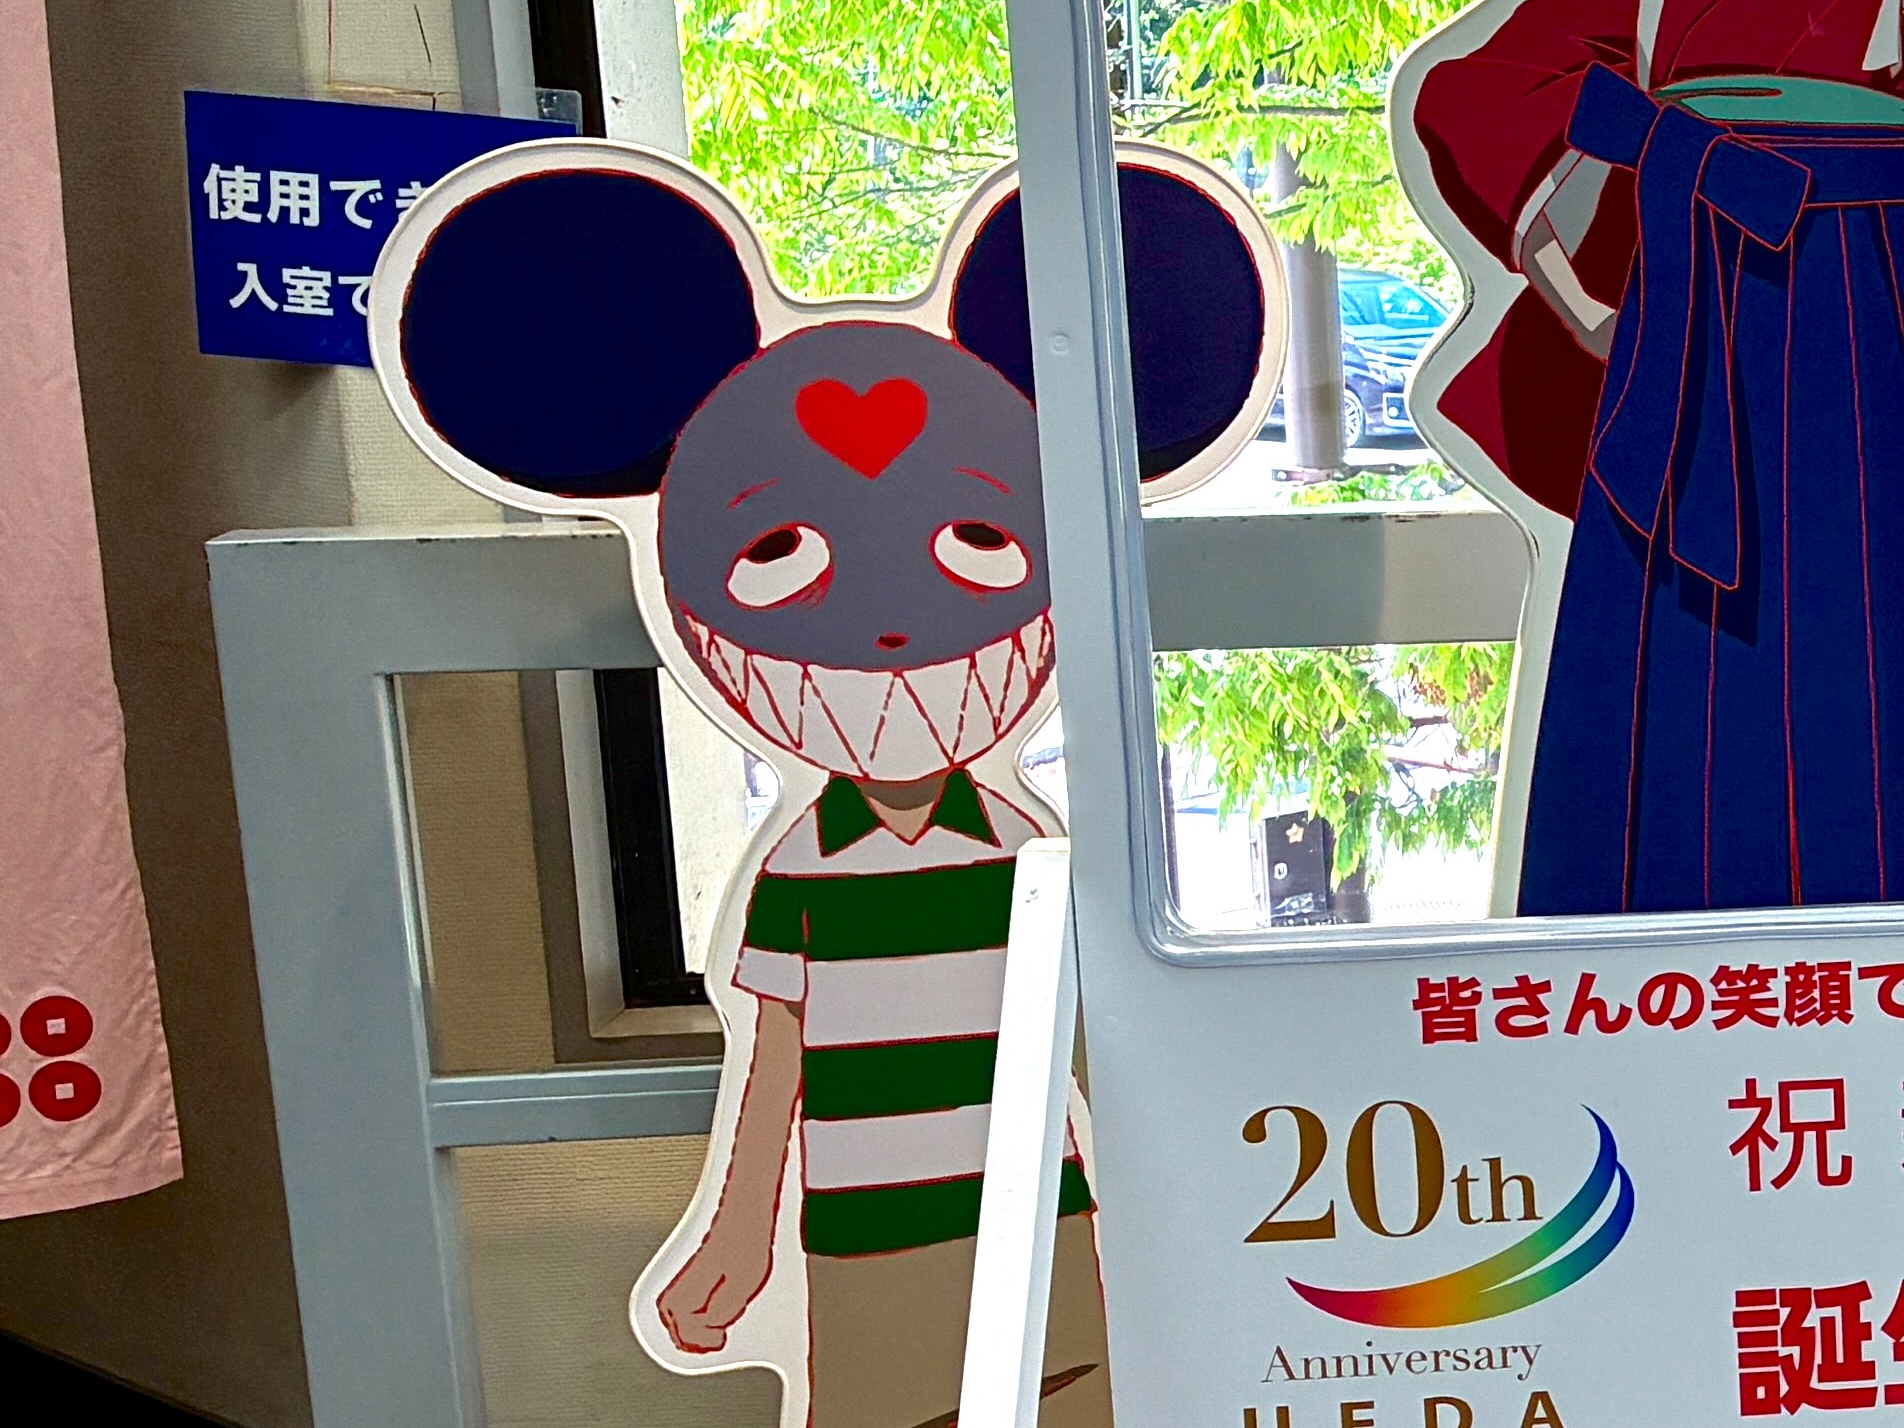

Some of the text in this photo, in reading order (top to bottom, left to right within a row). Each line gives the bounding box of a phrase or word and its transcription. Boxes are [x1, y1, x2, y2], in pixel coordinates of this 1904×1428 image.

[1239, 1099, 1539, 1246] 20th
[1727, 1076, 1855, 1194] 祝
[1260, 1336, 1543, 1389] Anniversary
